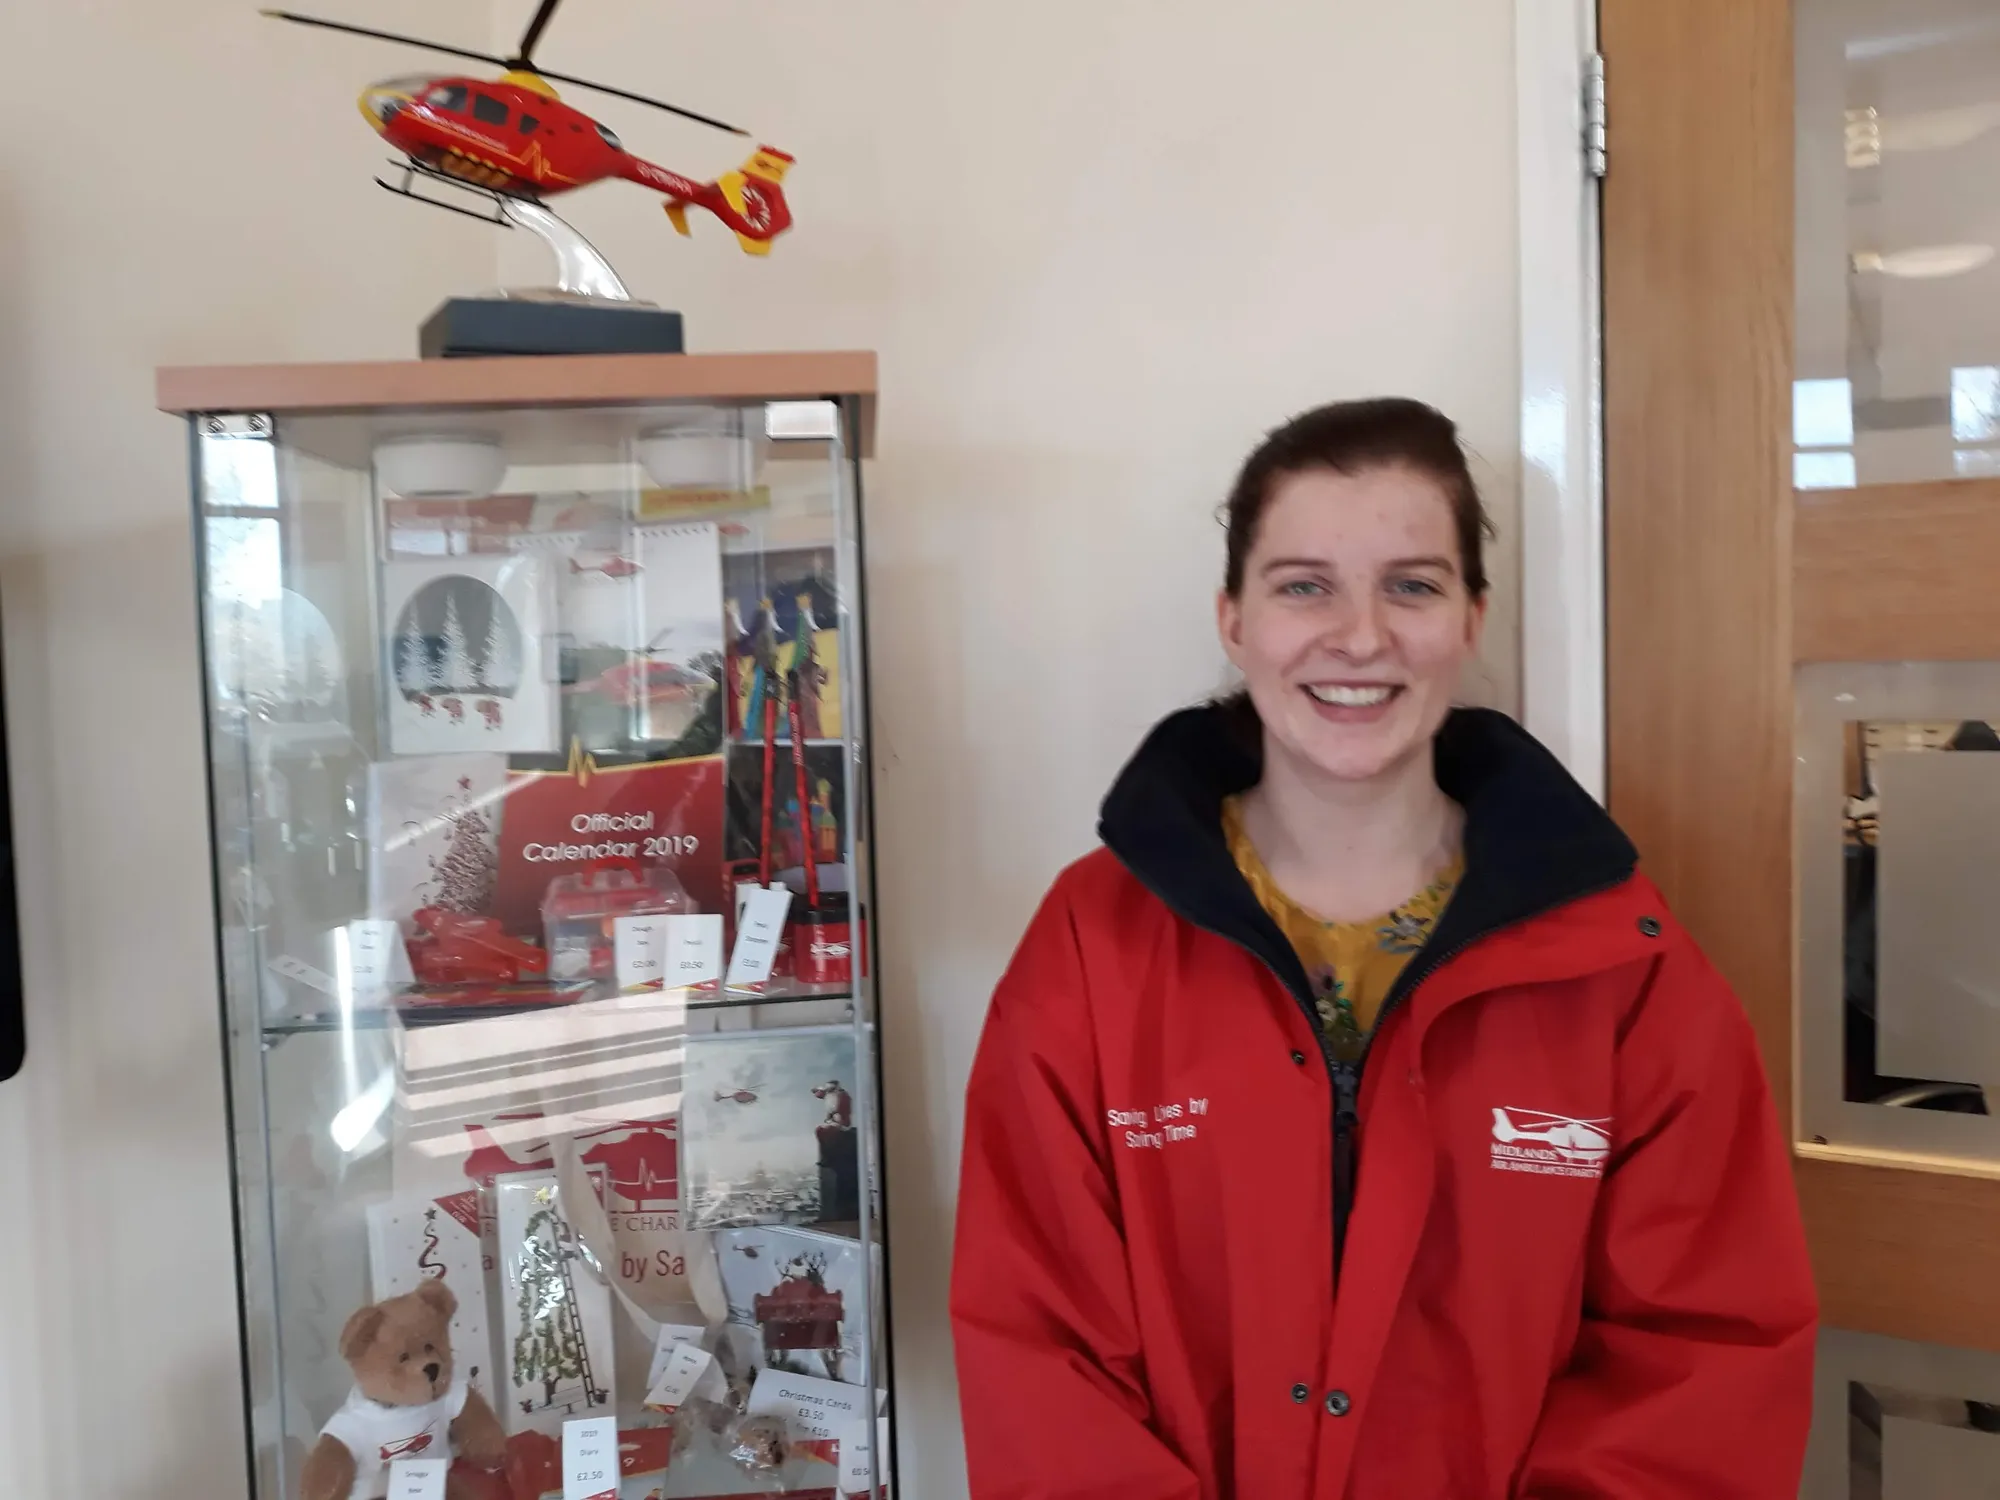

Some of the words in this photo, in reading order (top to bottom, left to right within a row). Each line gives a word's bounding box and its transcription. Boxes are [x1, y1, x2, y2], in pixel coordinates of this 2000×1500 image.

[571, 810, 654, 834] Official
[522, 840, 639, 863] Calendar
[643, 834, 700, 857] 2019
[1490, 1142, 1558, 1161] MIDLANDS
[621, 1250, 647, 1284] by
[778, 1388, 824, 1406] Christmas
[825, 1398, 852, 1411] Cards
[798, 1408, 825, 1421] £3.50
[576, 1470, 604, 1482] £2.50
